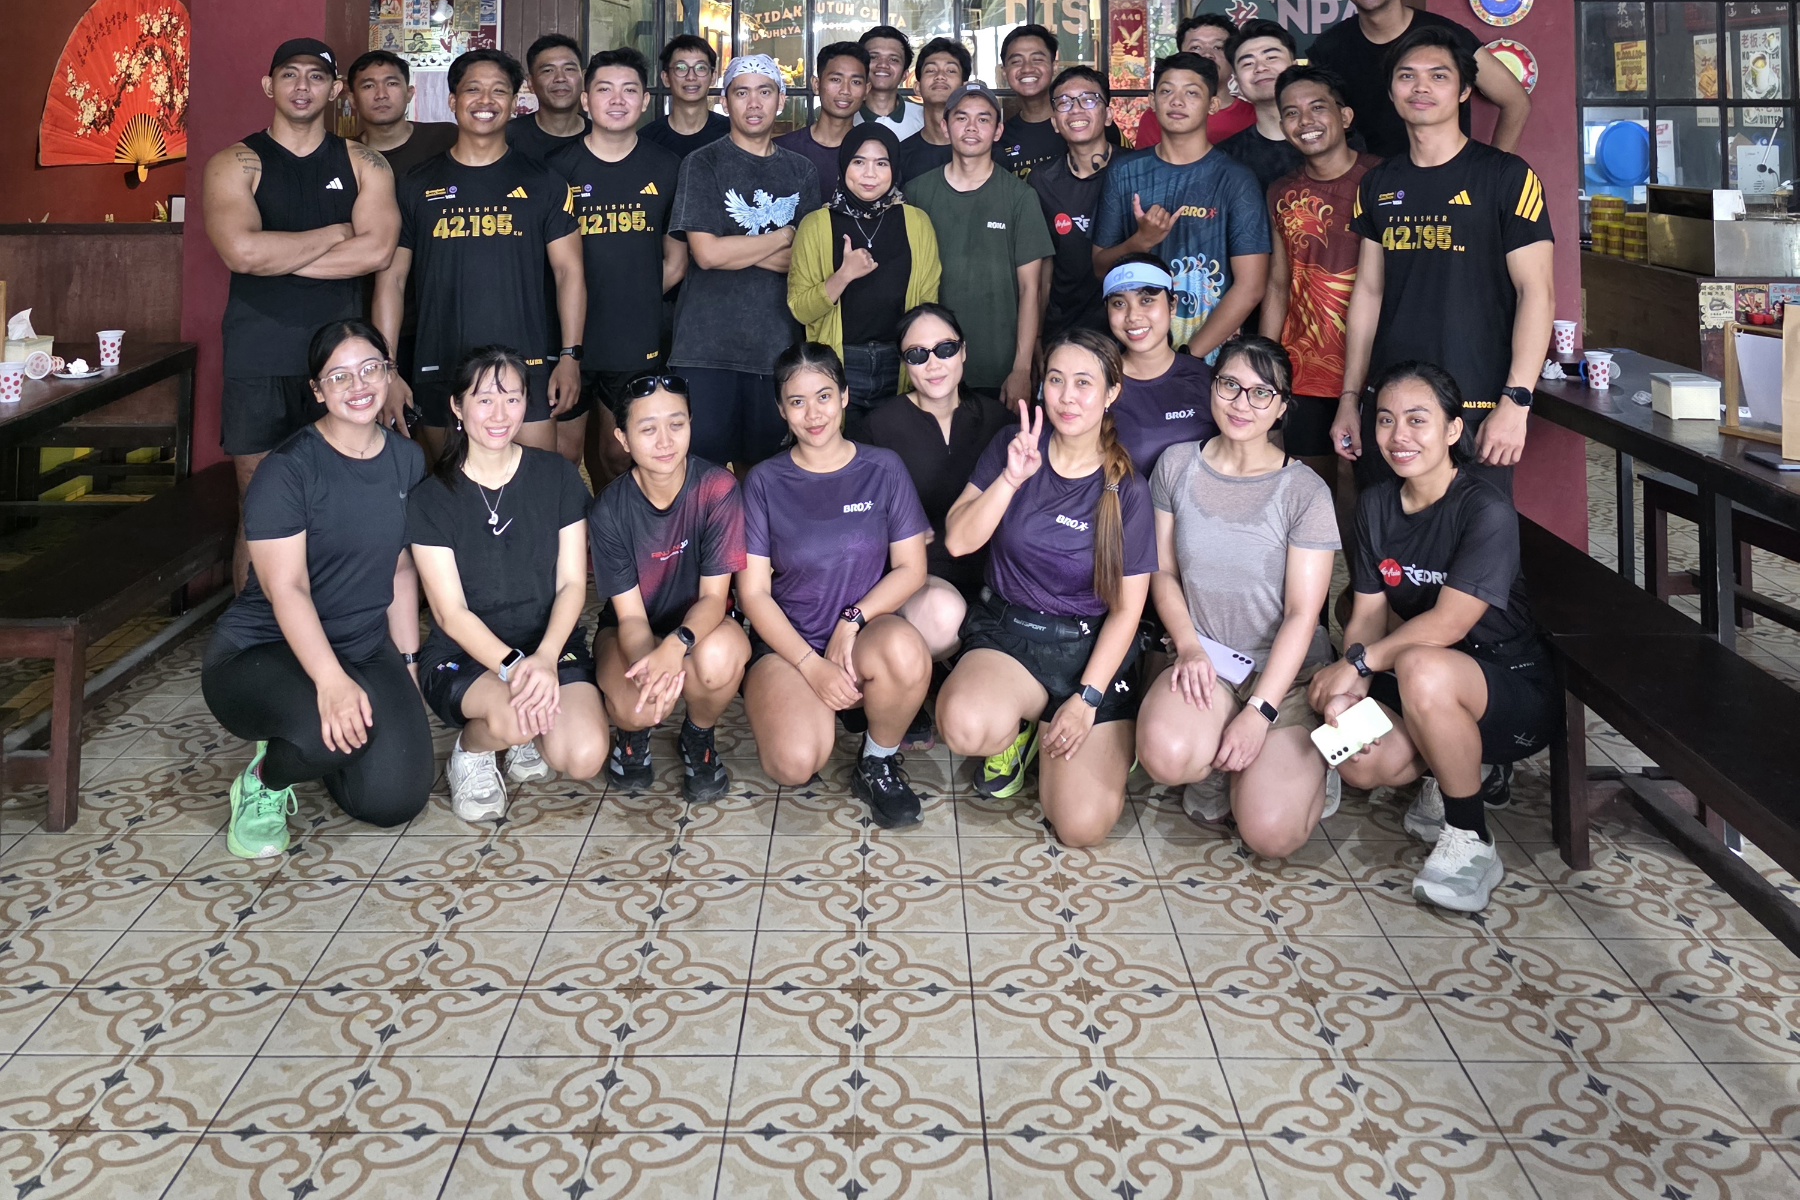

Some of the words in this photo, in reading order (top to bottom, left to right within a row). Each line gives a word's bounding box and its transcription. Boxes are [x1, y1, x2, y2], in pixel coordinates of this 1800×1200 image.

[754, 5, 803, 24] TIDAK
[816, 1, 855, 16] UTUH
[860, 6, 907, 28] CITA
[442, 205, 508, 215] FINISHER
[582, 202, 641, 212] FINISHER
[433, 213, 513, 239] 42,195
[1389, 215, 1448, 223] FINISHER
[1382, 224, 1452, 251] 42,195
[1113, 267, 1134, 282] alo
